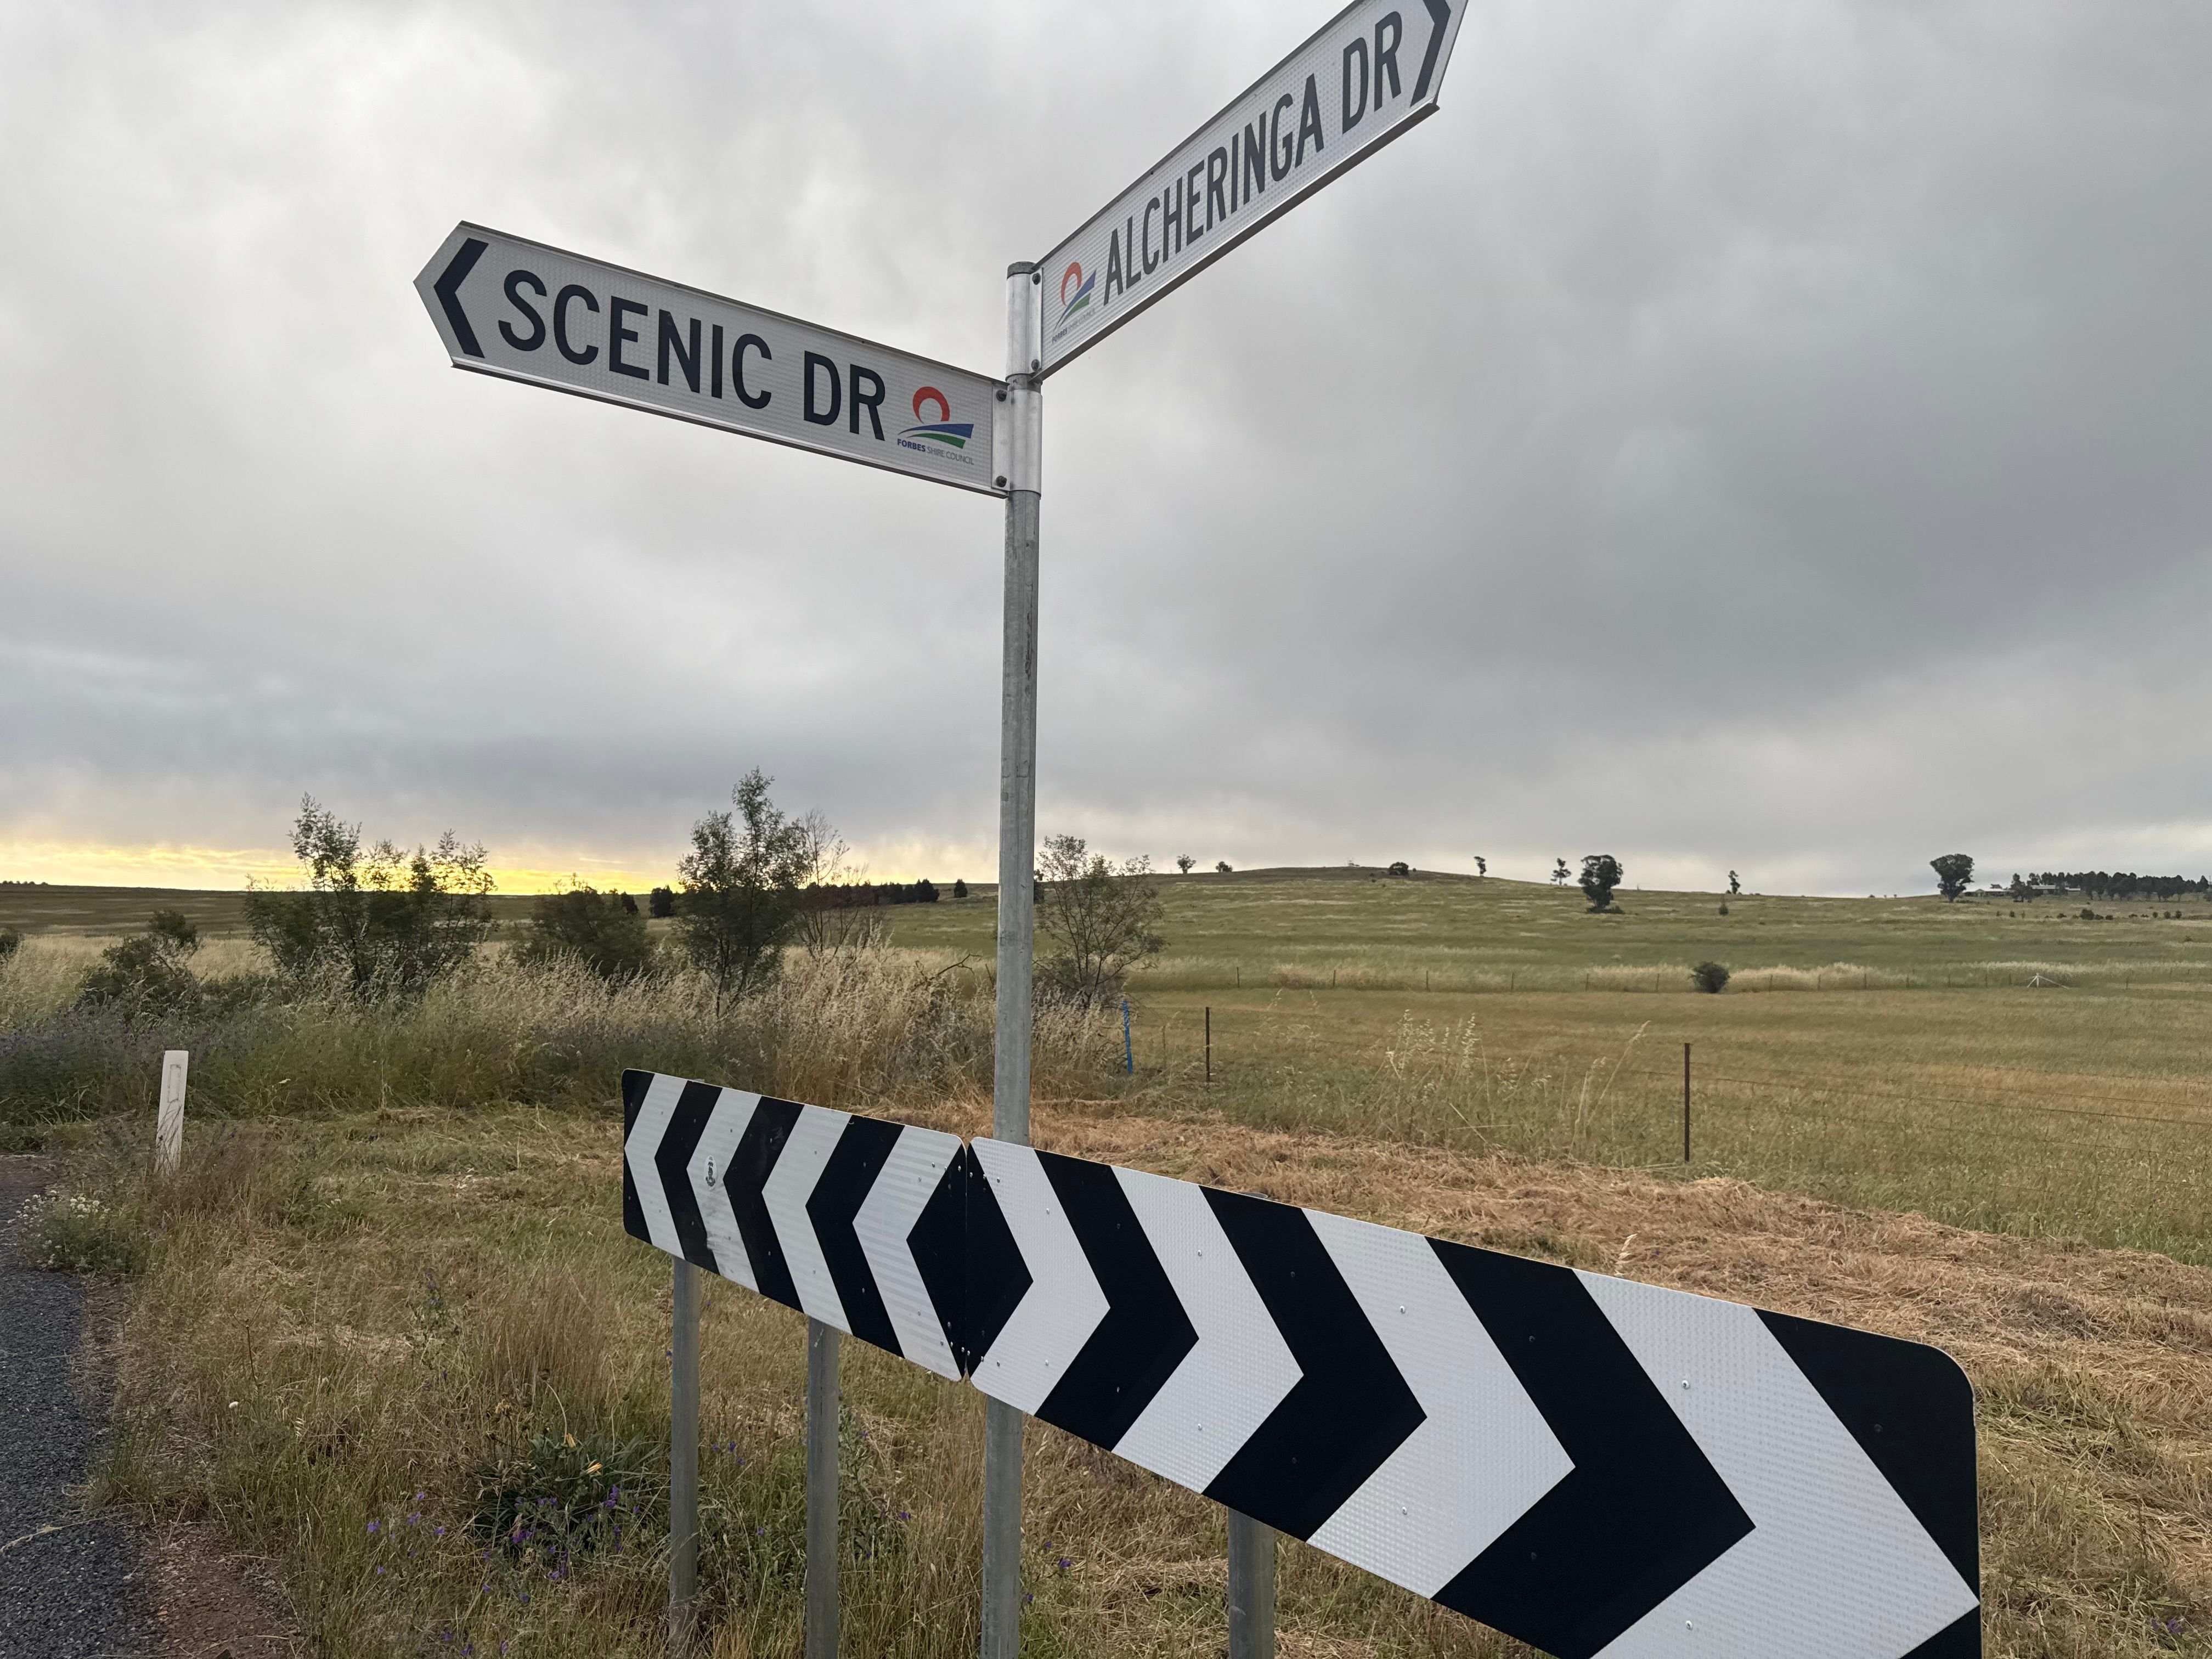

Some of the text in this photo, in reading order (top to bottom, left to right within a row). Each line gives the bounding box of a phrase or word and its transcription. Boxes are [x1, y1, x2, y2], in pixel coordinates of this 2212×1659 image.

[1103, 11, 1402, 306] ALCHERINGA DR
[498, 269, 885, 442] SCENIC DR
[897, 438, 975, 465] FORBES SHIRE COUNCIL
